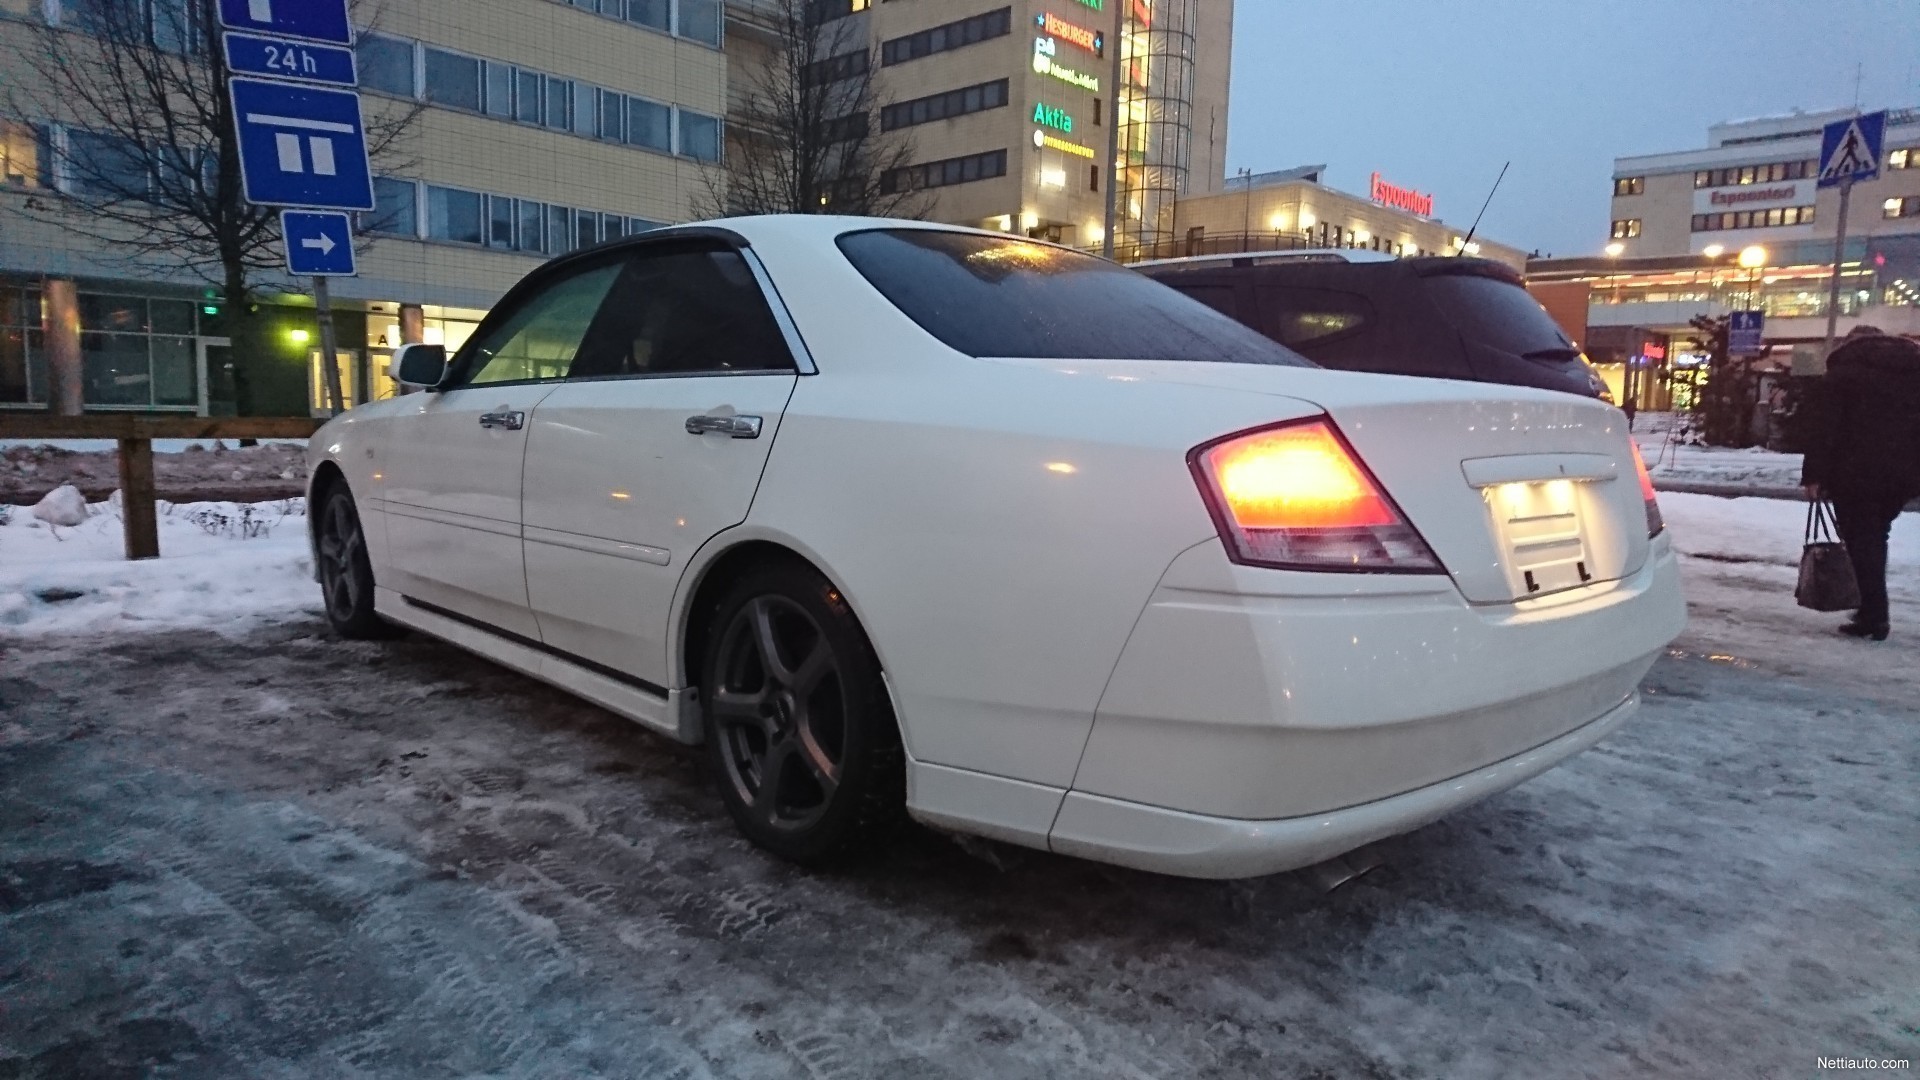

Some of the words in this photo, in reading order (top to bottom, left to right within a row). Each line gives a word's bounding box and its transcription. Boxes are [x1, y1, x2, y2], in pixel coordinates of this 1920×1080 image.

[1045, 12, 1094, 52] HESBURGER
[1034, 102, 1072, 133] Aktia
[1371, 171, 1433, 217] Espoontori
